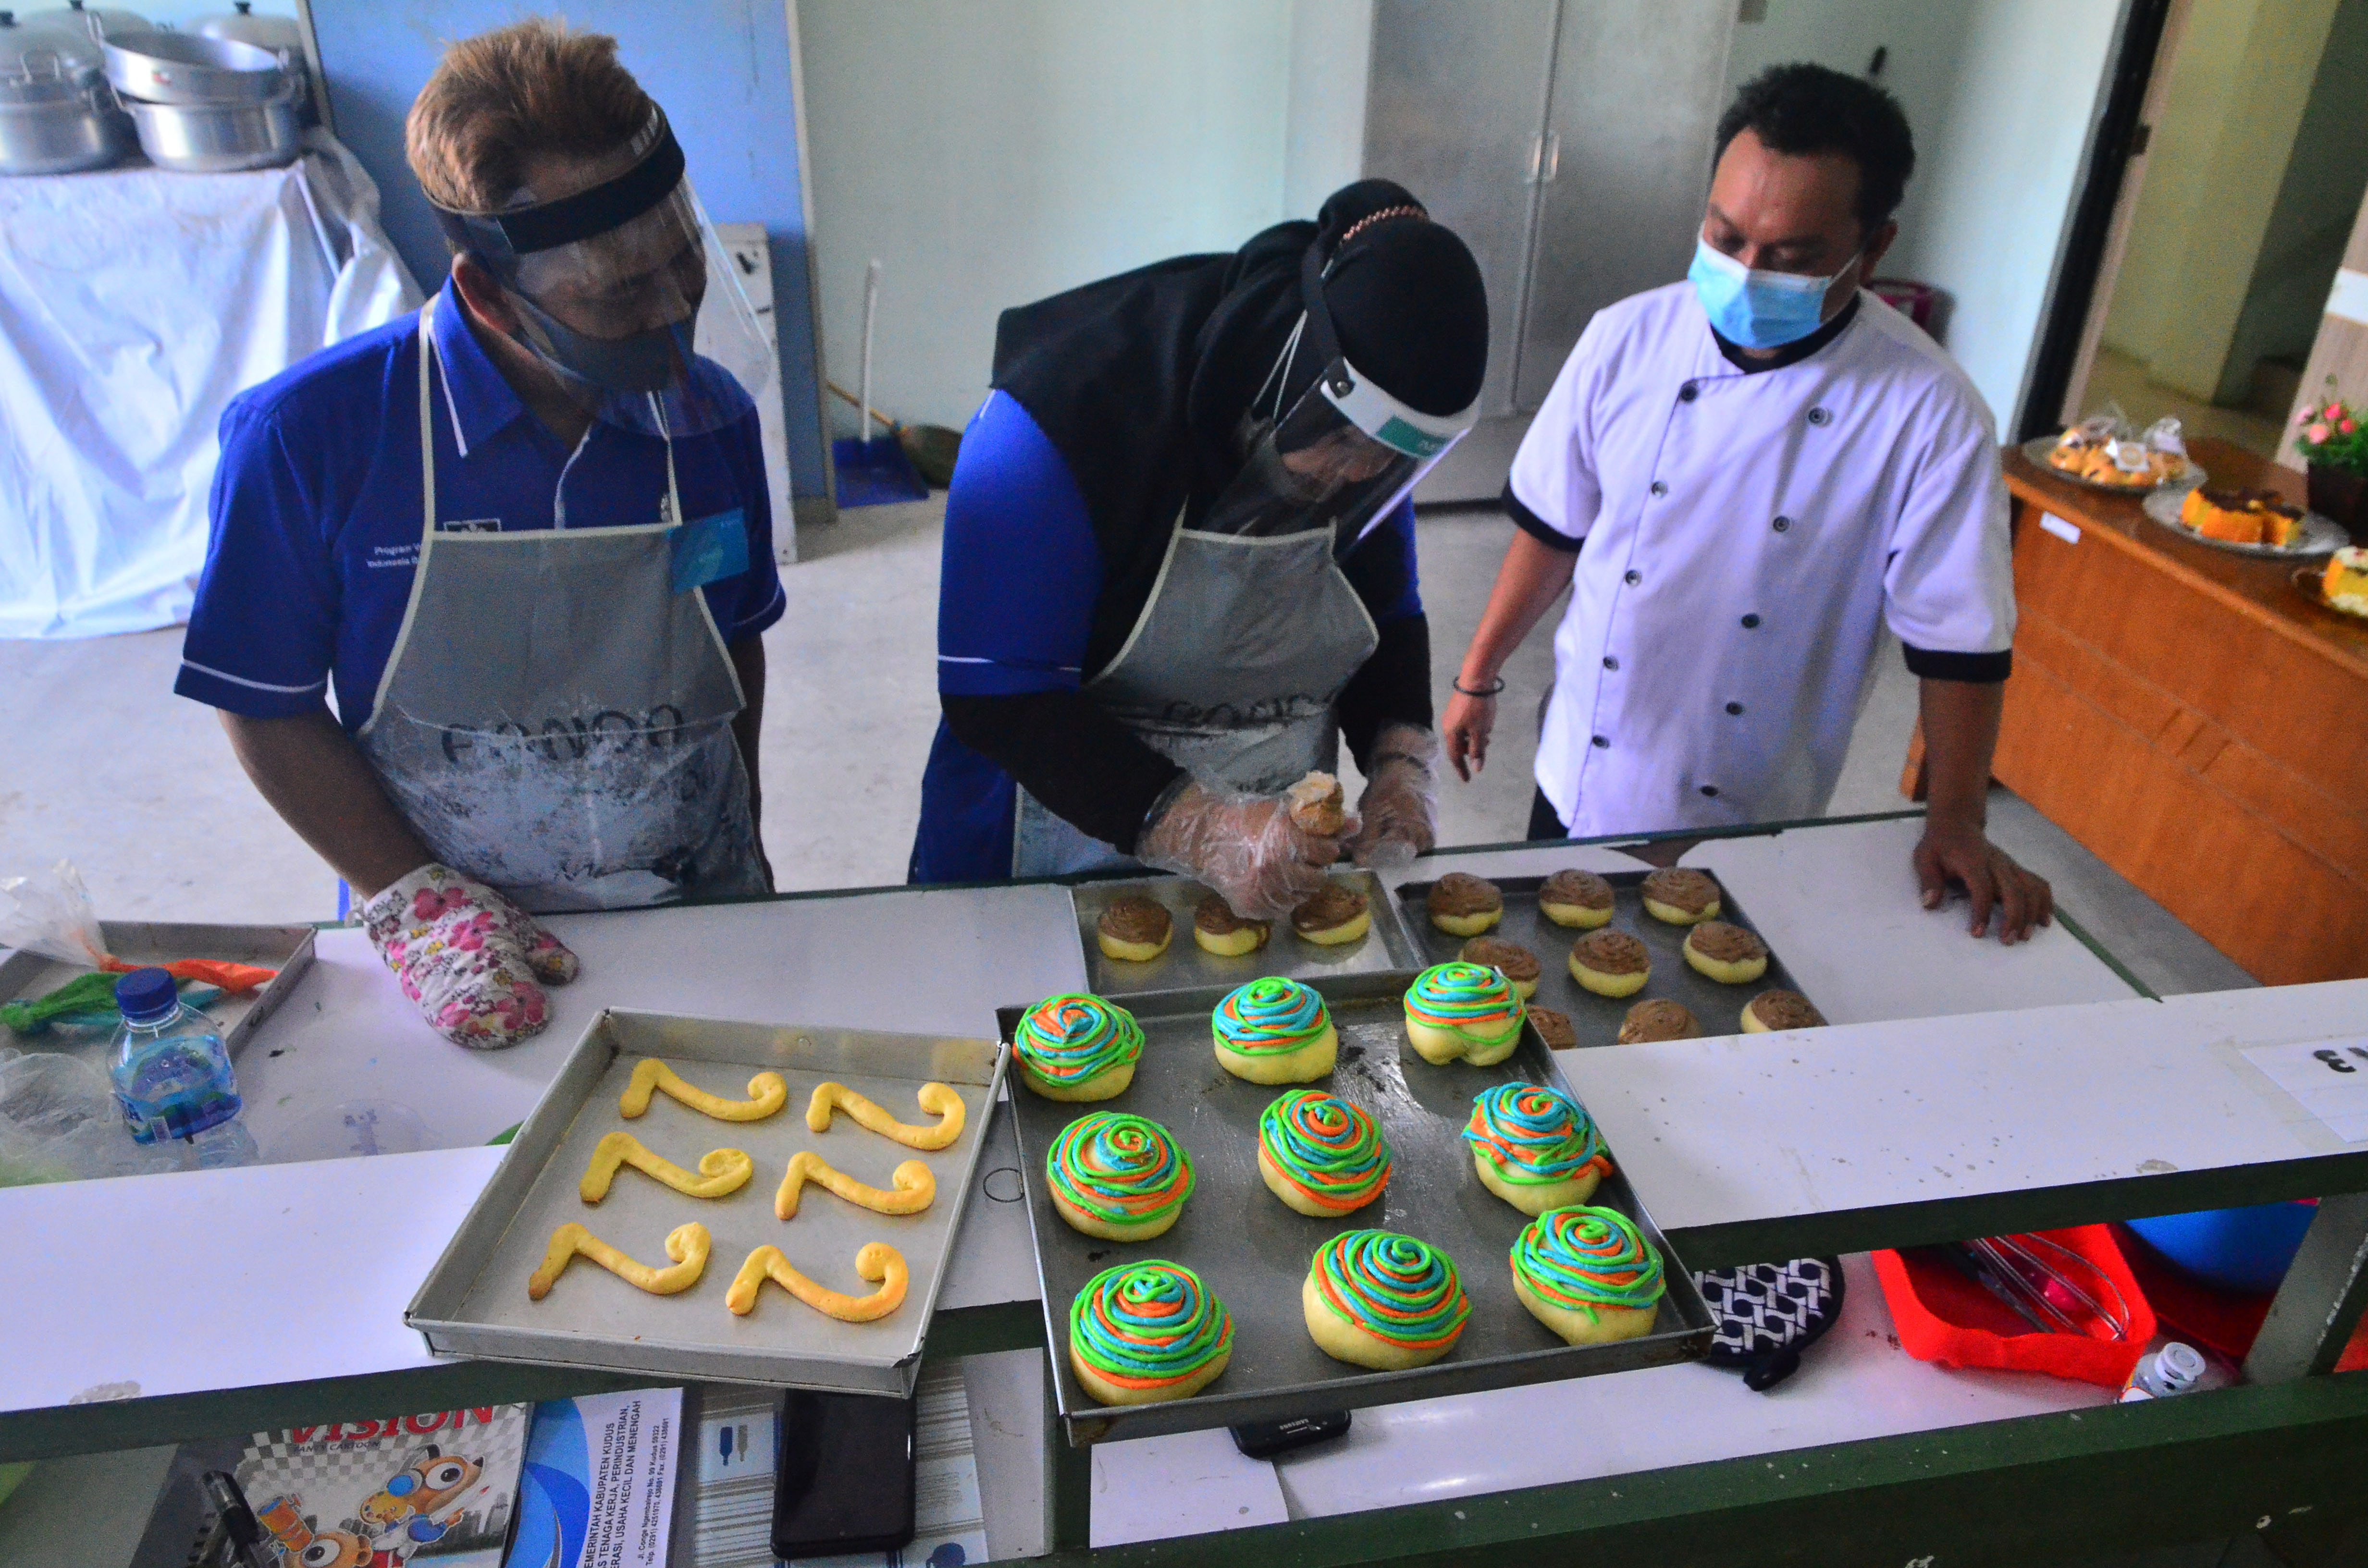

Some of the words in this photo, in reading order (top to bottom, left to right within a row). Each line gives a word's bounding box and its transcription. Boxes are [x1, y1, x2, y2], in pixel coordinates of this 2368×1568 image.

[628, 1400, 641, 1452] MENENGAH
[612, 1405, 630, 1482] PERINDUSTRIAN,
[650, 1445, 658, 1465] Kudus
[625, 1455, 635, 1474] DAN
[585, 1514, 602, 1568] EMERINTAH
[594, 1457, 610, 1512] KABUPATEN
[604, 1422, 615, 1454] KUDUS
[606, 1484, 619, 1517] KERJA,
[621, 1477, 632, 1503] KECIL
[616, 1505, 628, 1538] USAHA
[600, 1519, 614, 1558] TENAGA
[611, 1540, 625, 1568] ERASI,
